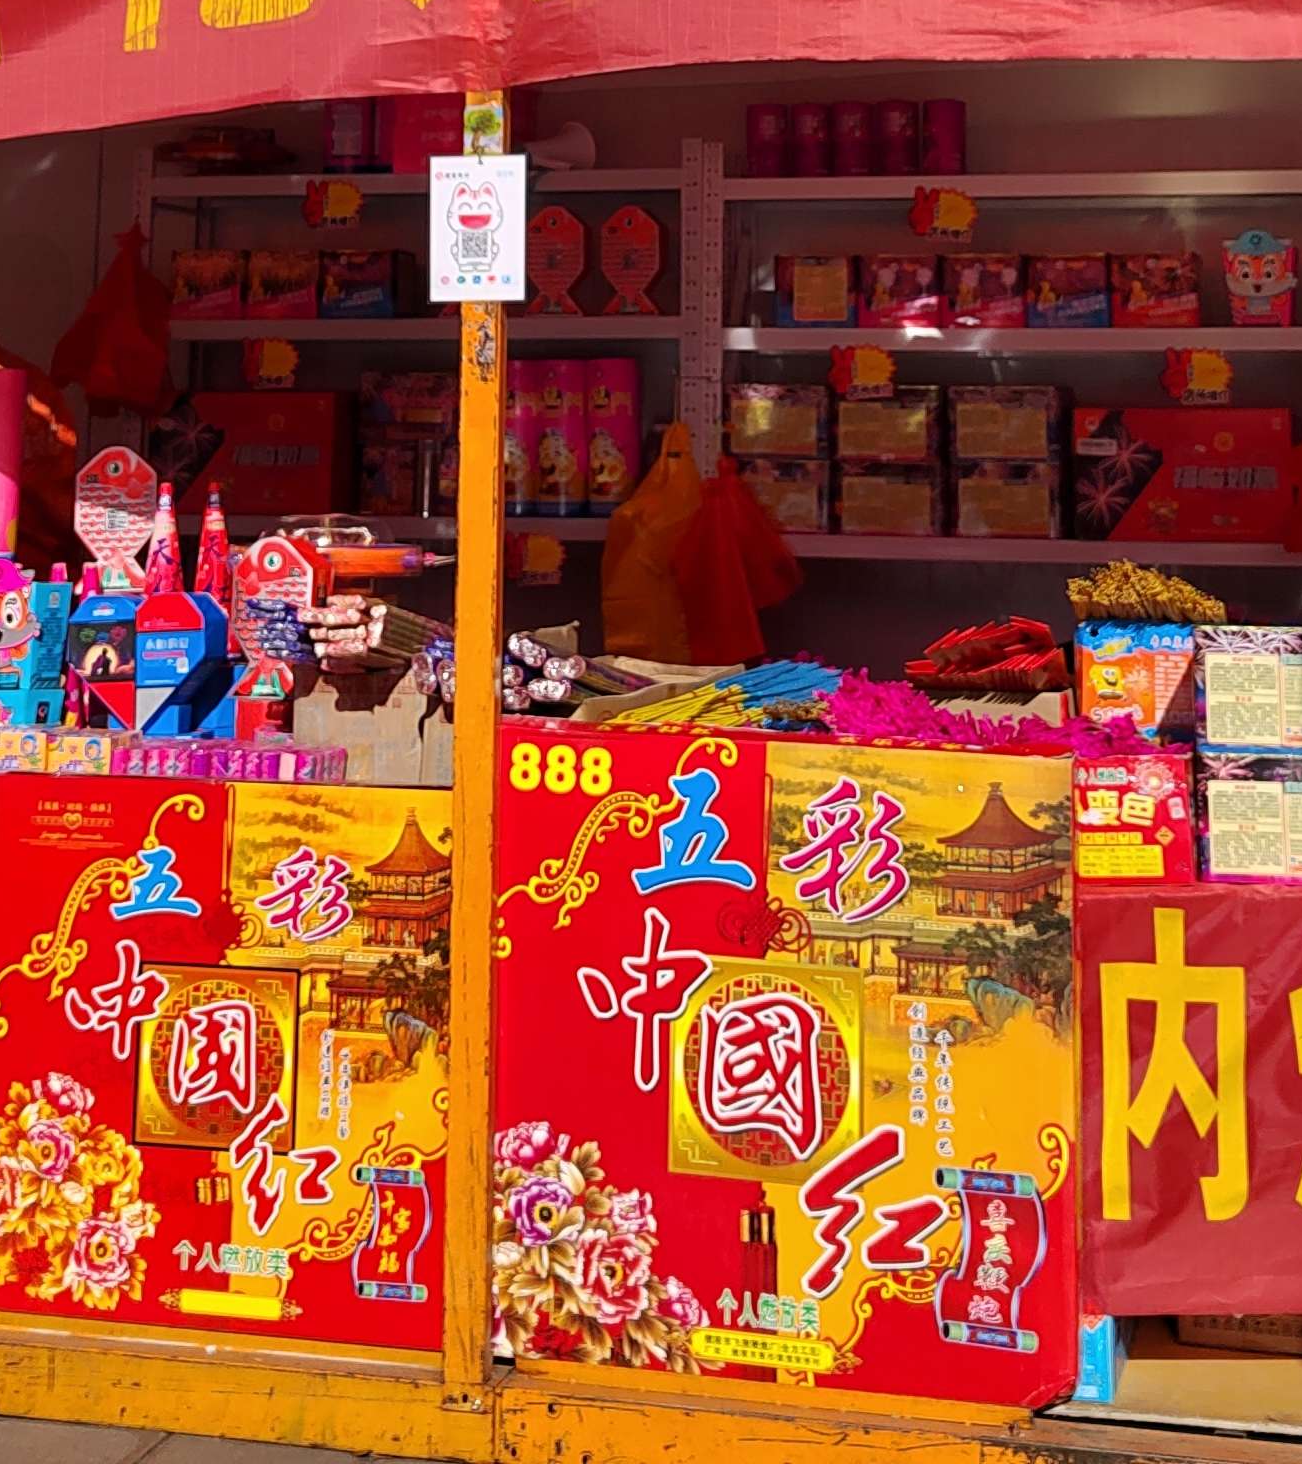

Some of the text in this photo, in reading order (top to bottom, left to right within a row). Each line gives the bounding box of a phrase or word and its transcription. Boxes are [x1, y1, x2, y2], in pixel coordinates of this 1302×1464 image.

[510, 743, 613, 796] 888
[632, 767, 910, 924] 五彩
[112, 846, 355, 944] 五彩
